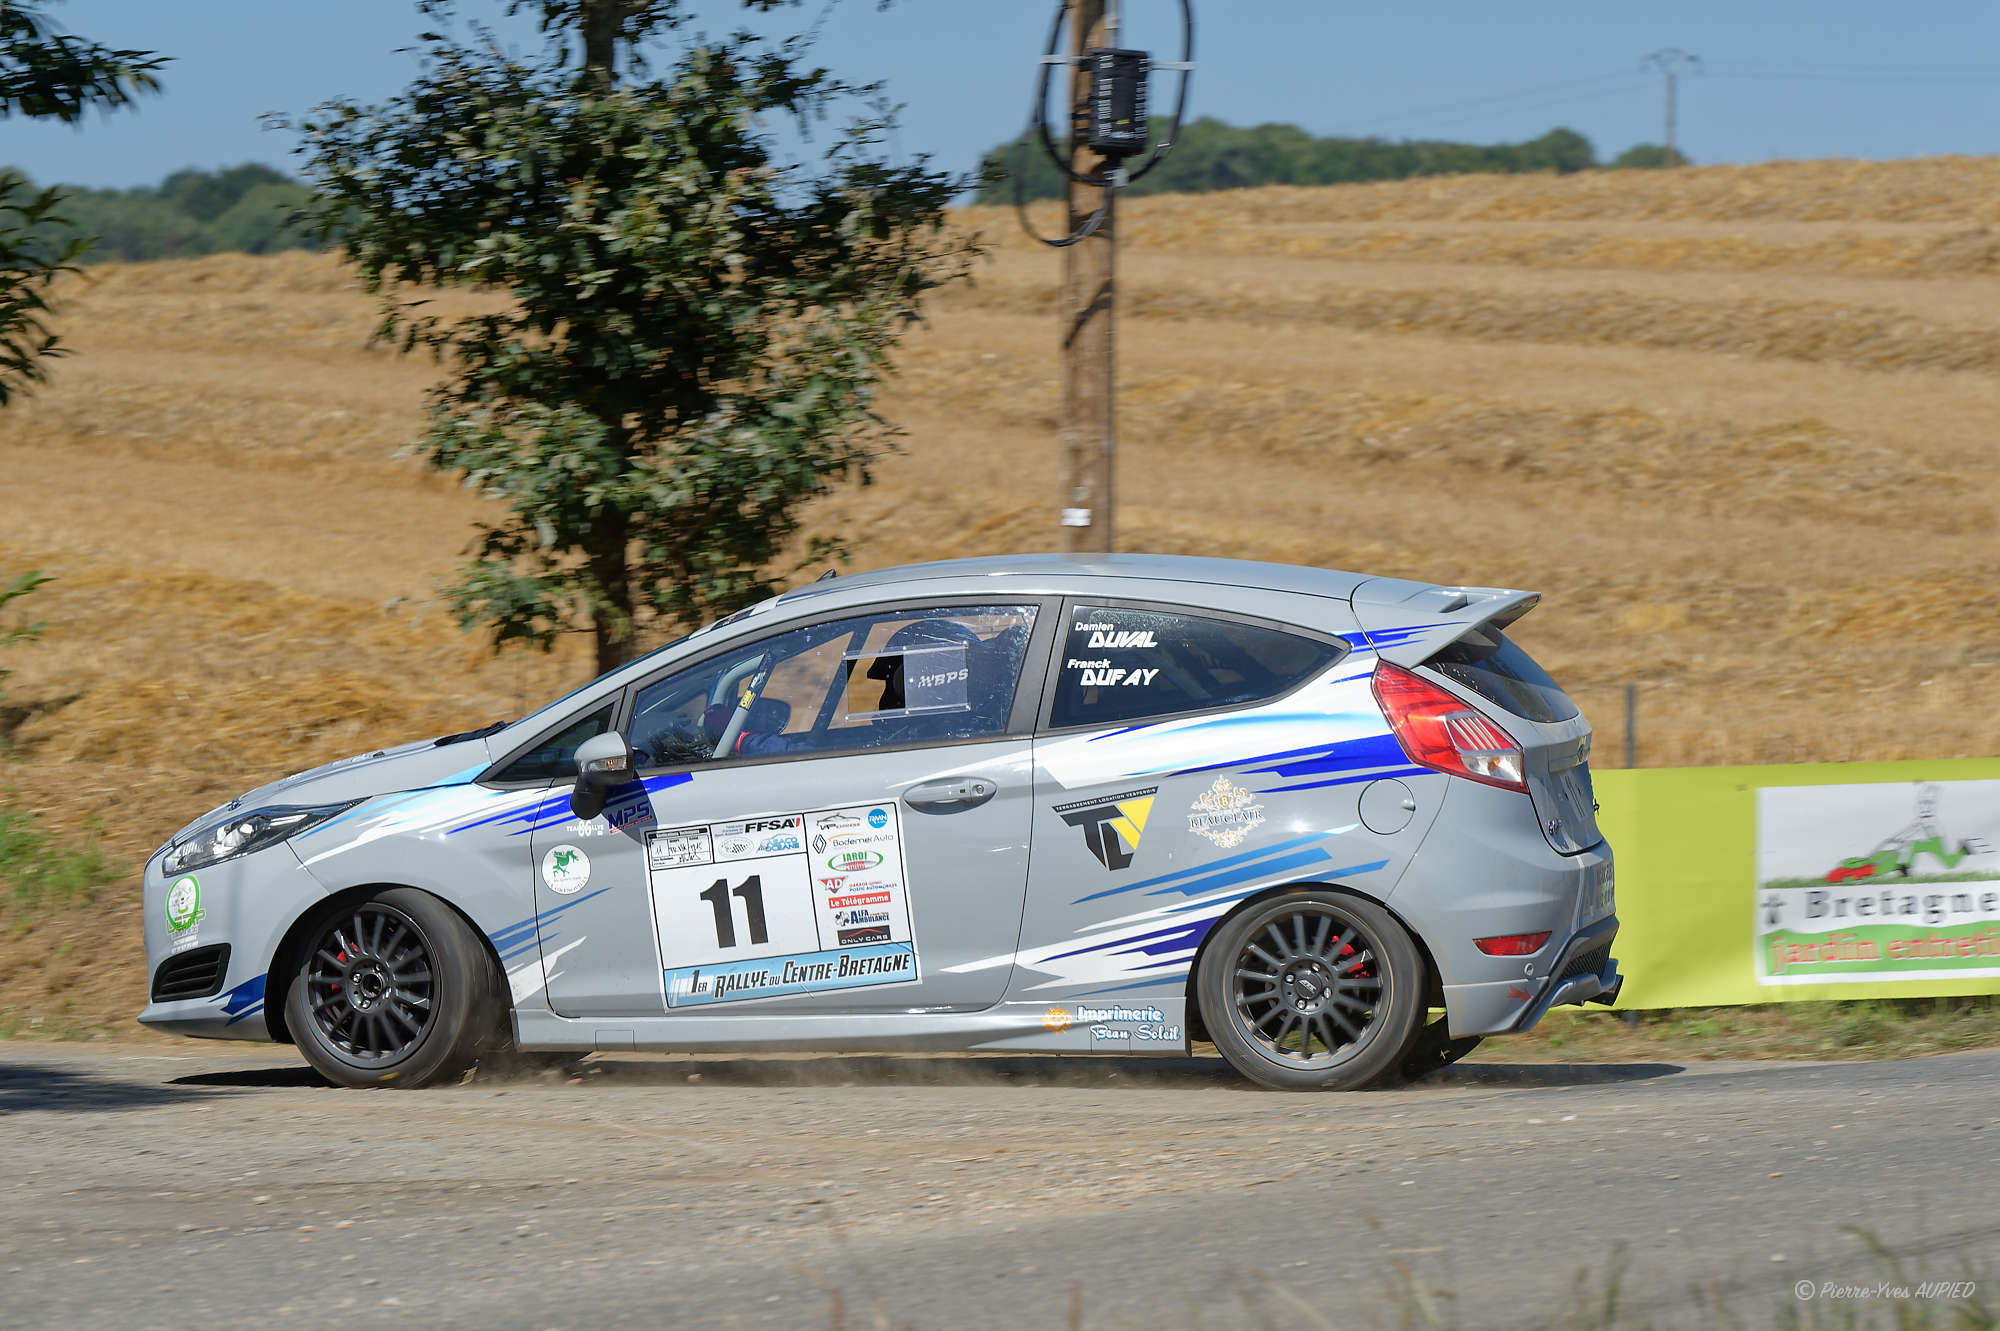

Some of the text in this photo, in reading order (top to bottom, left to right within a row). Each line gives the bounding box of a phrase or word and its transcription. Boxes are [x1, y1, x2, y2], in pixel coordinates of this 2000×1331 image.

[1075, 622, 1114, 631] Damien
[1087, 631, 1158, 648] DUVAL
[1067, 659, 1111, 669] Franck
[1080, 668, 1160, 686] DUFAY
[1098, 793, 1125, 803] LOCATION
[607, 801, 649, 829] MPS
[868, 814, 887, 824] RMN
[1190, 809, 1263, 828] BEAUCLAIR
[745, 819, 794, 833] FFSA
[826, 879, 843, 889] AD
[830, 895, 889, 907] Le Télégramme
[1804, 890, 1999, 925] Bretagne
[700, 875, 768, 948] 11
[865, 934, 888, 942] CARS
[1770, 933, 1880, 975] jardin
[713, 970, 768, 998] RALLYE
[769, 976, 781, 986] DU
[782, 954, 910, 984] CENTRE-BRETAGNE
[1077, 1005, 1164, 1023] Imprimerie
[1089, 1024, 1180, 1041] Beau Soleil
